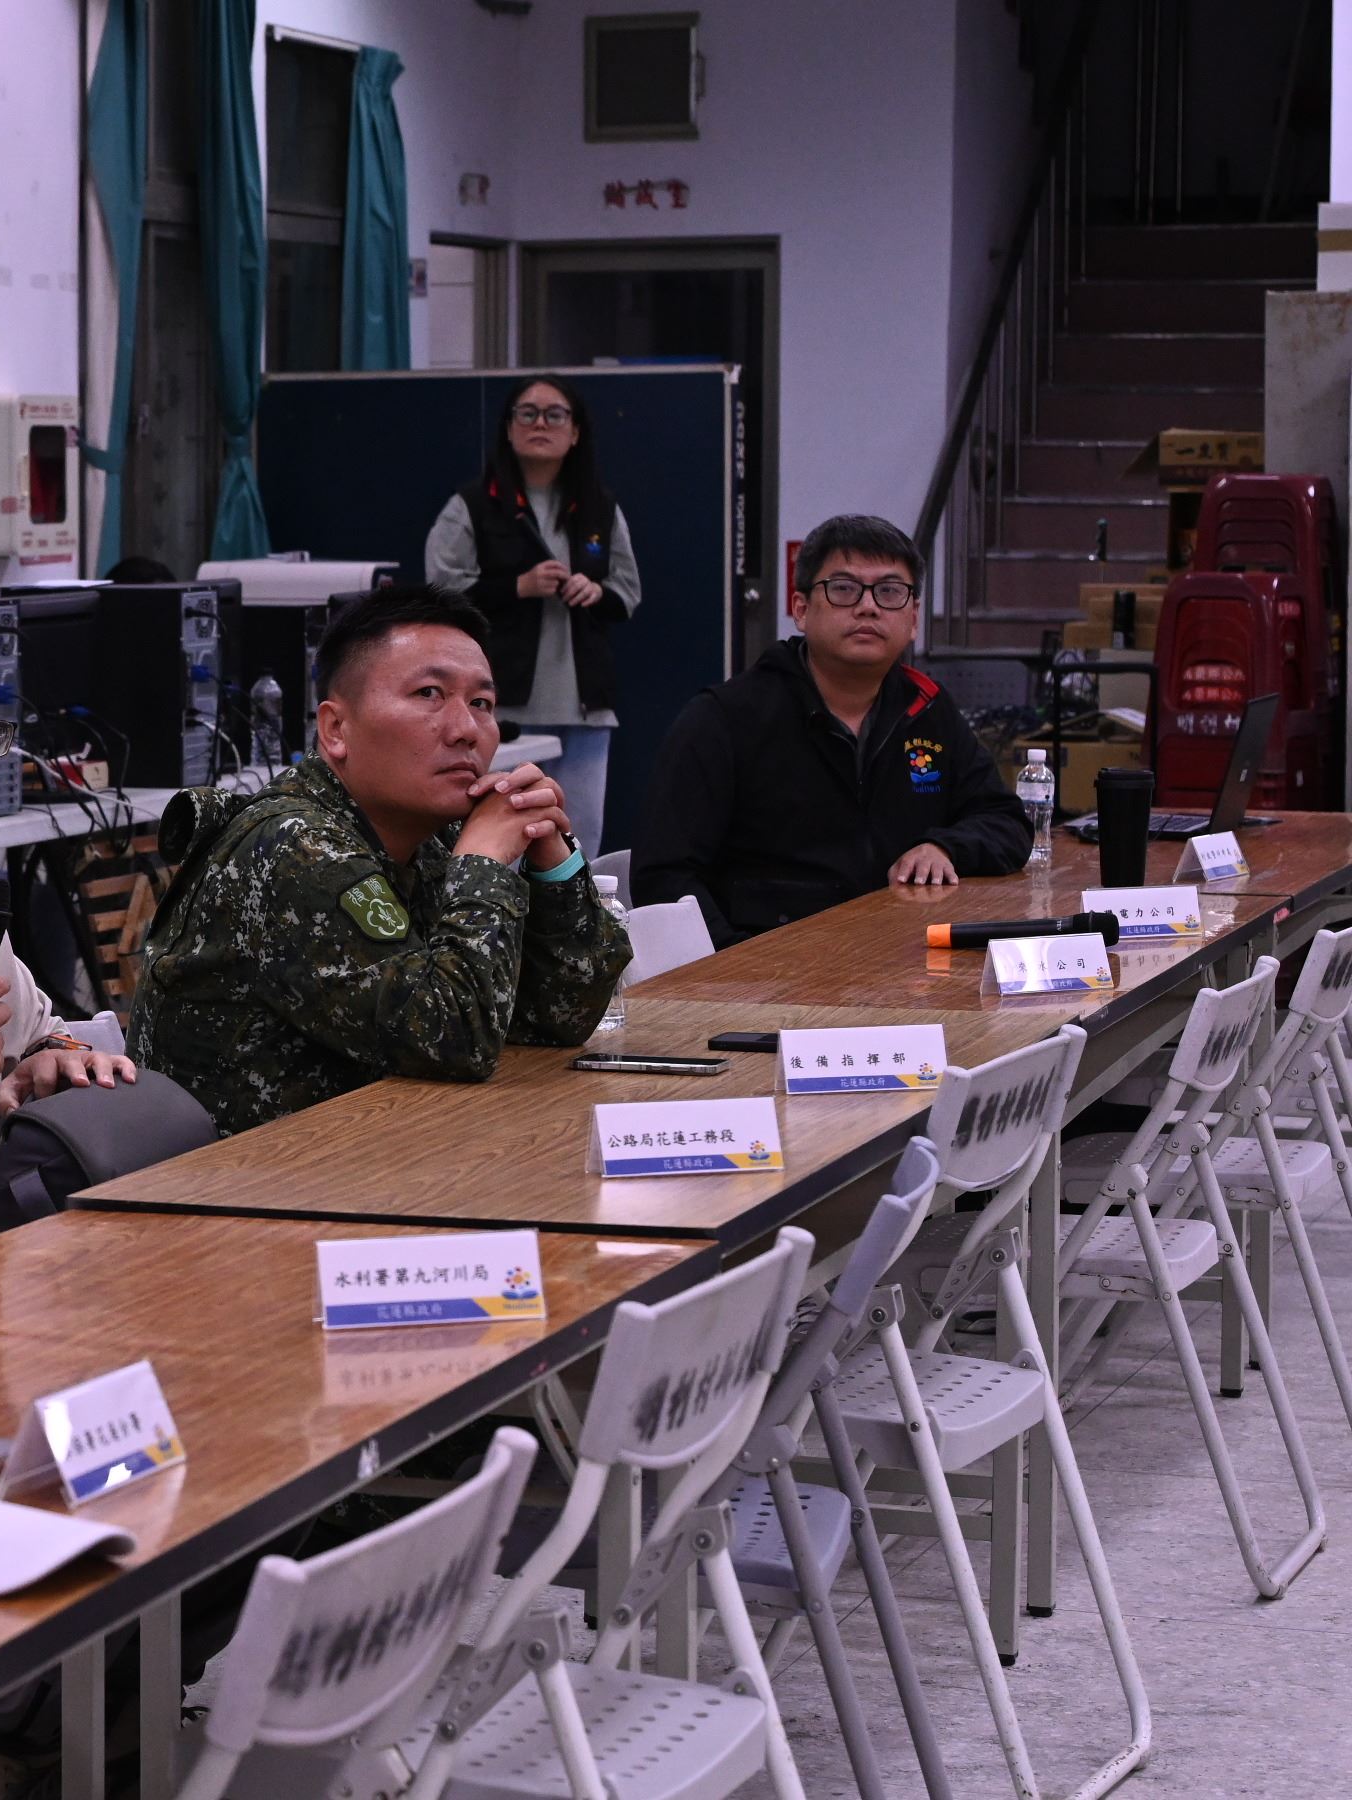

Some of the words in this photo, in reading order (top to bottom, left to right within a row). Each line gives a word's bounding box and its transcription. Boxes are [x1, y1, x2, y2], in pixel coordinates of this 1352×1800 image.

[1104, 906, 1175, 919] 電力公司
[1016, 958, 1085, 973] 來水公司
[790, 1053, 906, 1069] 後備指揮部
[840, 1078, 886, 1088] 花蓮縣政府
[608, 1129, 736, 1148] 公路局花蓮工務段
[663, 1157, 714, 1169] 花蓮縣政府
[334, 1264, 490, 1288] 水利署第九河川局
[377, 1304, 443, 1319] 花蓮縣政府
